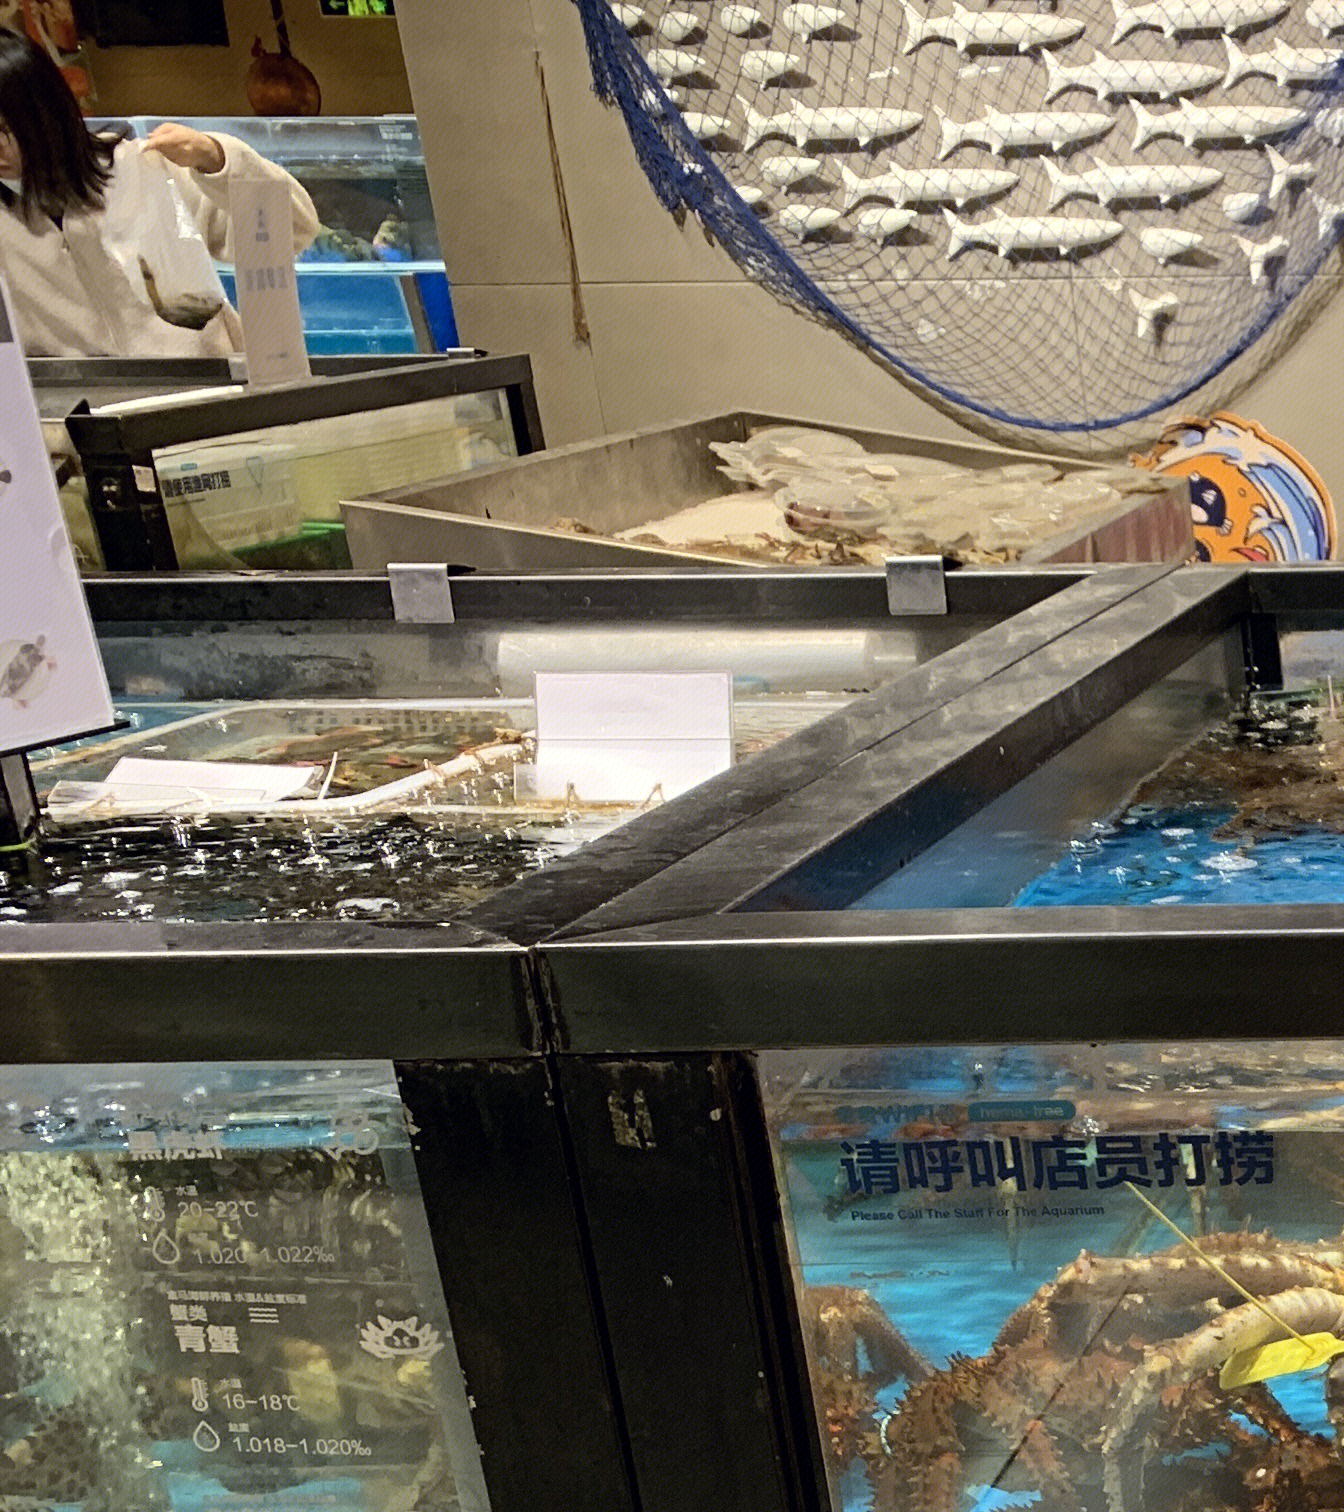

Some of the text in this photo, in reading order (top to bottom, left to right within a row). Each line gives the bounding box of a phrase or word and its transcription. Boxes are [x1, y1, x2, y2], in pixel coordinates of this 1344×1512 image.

[839, 1129, 1276, 1196] 请呼叫店员打捞
[851, 1210, 894, 1222] Please
[897, 1209, 924, 1221] Call
[927, 1208, 951, 1219] The
[988, 1207, 1010, 1218] For
[1014, 1206, 1039, 1218] The
[1041, 1203, 1105, 1219] Aquarium
[169, 1303, 208, 1322] 蟹类
[173, 1323, 241, 1354] 青蟹
[232, 1437, 372, 1457] 1.018-1.020‰
